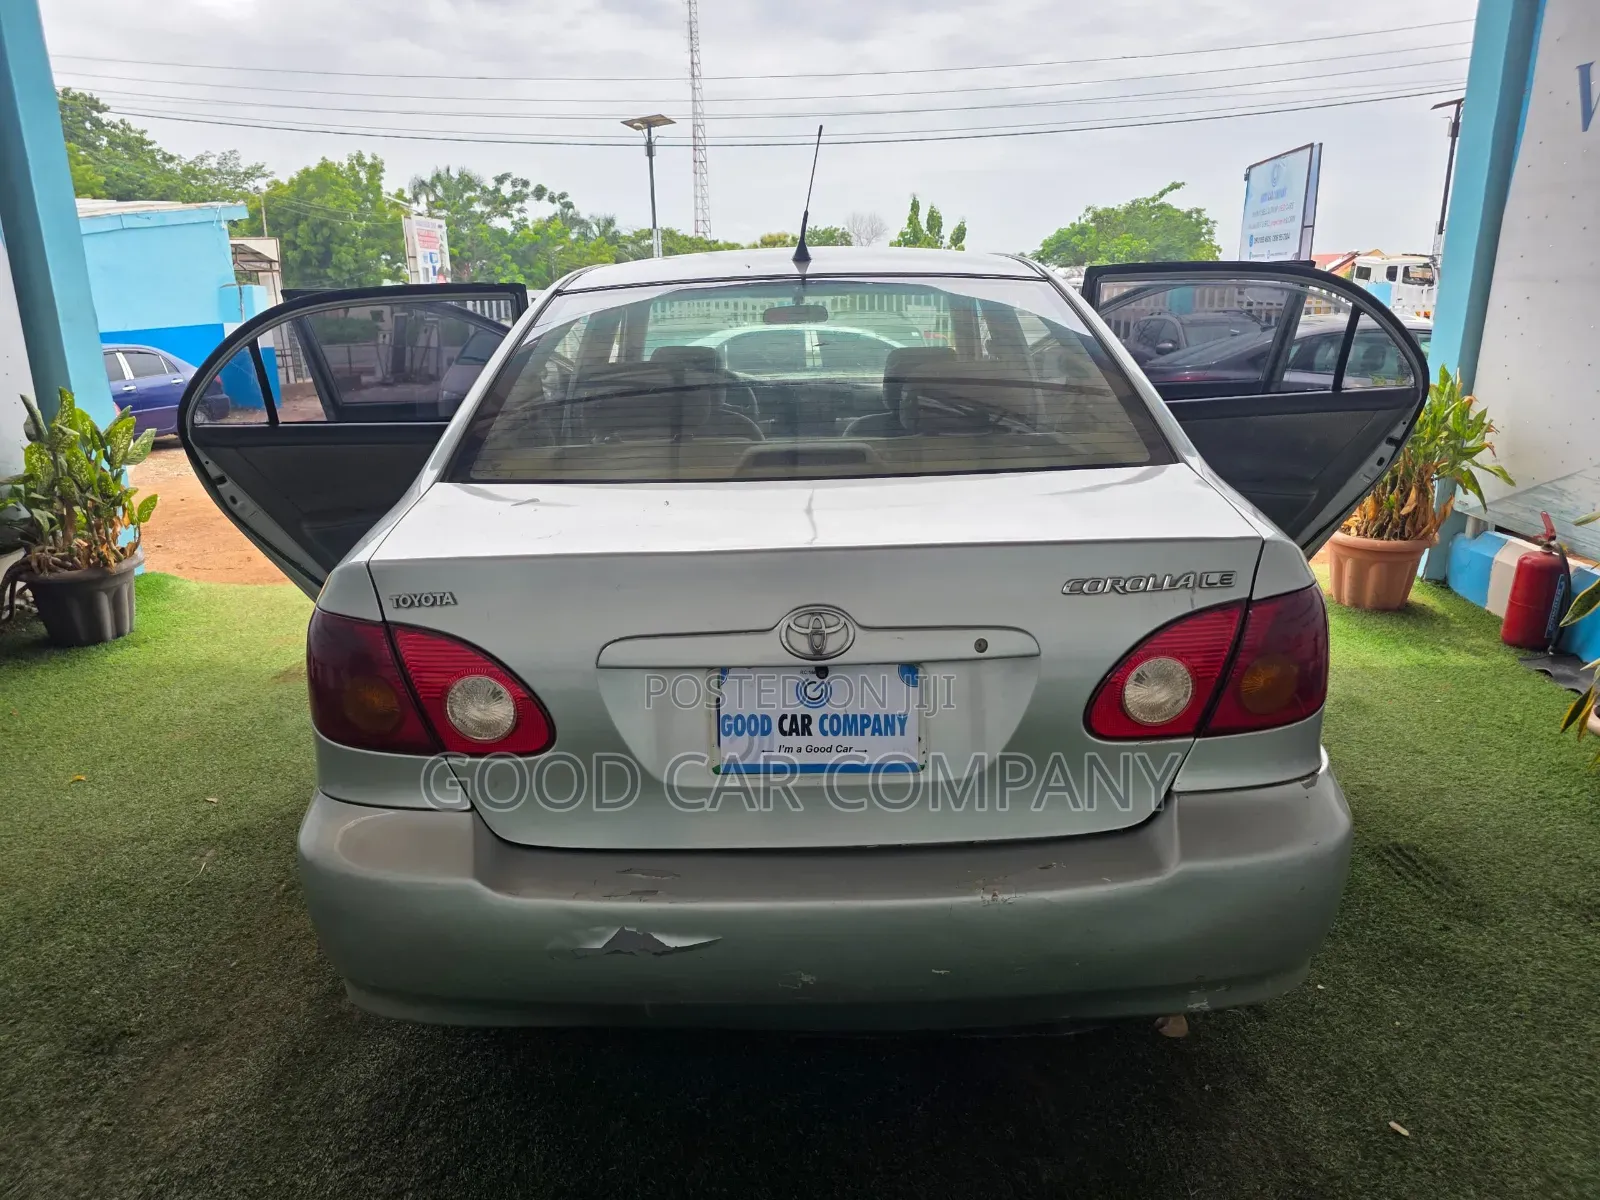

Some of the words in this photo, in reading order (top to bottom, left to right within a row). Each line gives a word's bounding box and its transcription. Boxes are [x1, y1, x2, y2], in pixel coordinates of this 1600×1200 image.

[1061, 571, 1197, 595] COROLLA
[1200, 571, 1237, 588] LE
[389, 591, 458, 609] TOYOTA
[721, 714, 772, 736] GOOD
[778, 714, 813, 736] CAR
[819, 714, 908, 736] COMPANY
[778, 745, 794, 753] I'm
[805, 745, 833, 753] Good
[835, 745, 853, 753] Car
